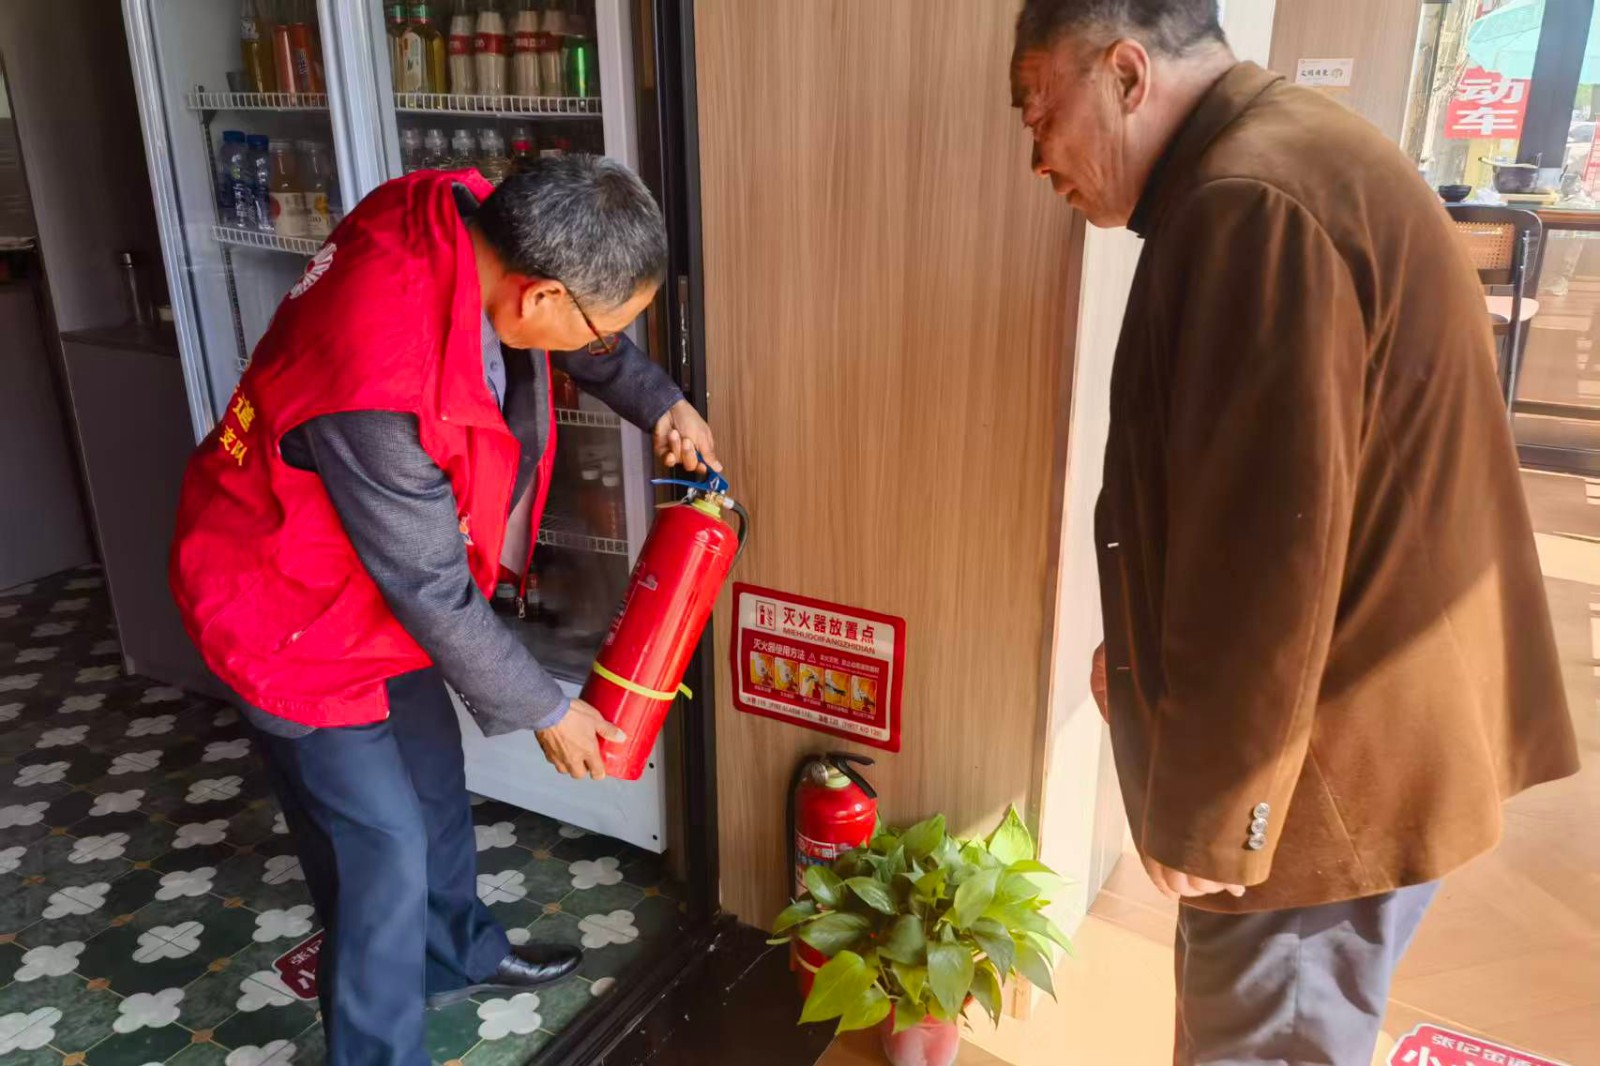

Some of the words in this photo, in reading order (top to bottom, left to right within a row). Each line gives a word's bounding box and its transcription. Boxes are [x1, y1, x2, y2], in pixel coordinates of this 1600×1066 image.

[783, 606, 875, 645] 灭火器放置点
[753, 637, 806, 661] 灭火器使用方法
